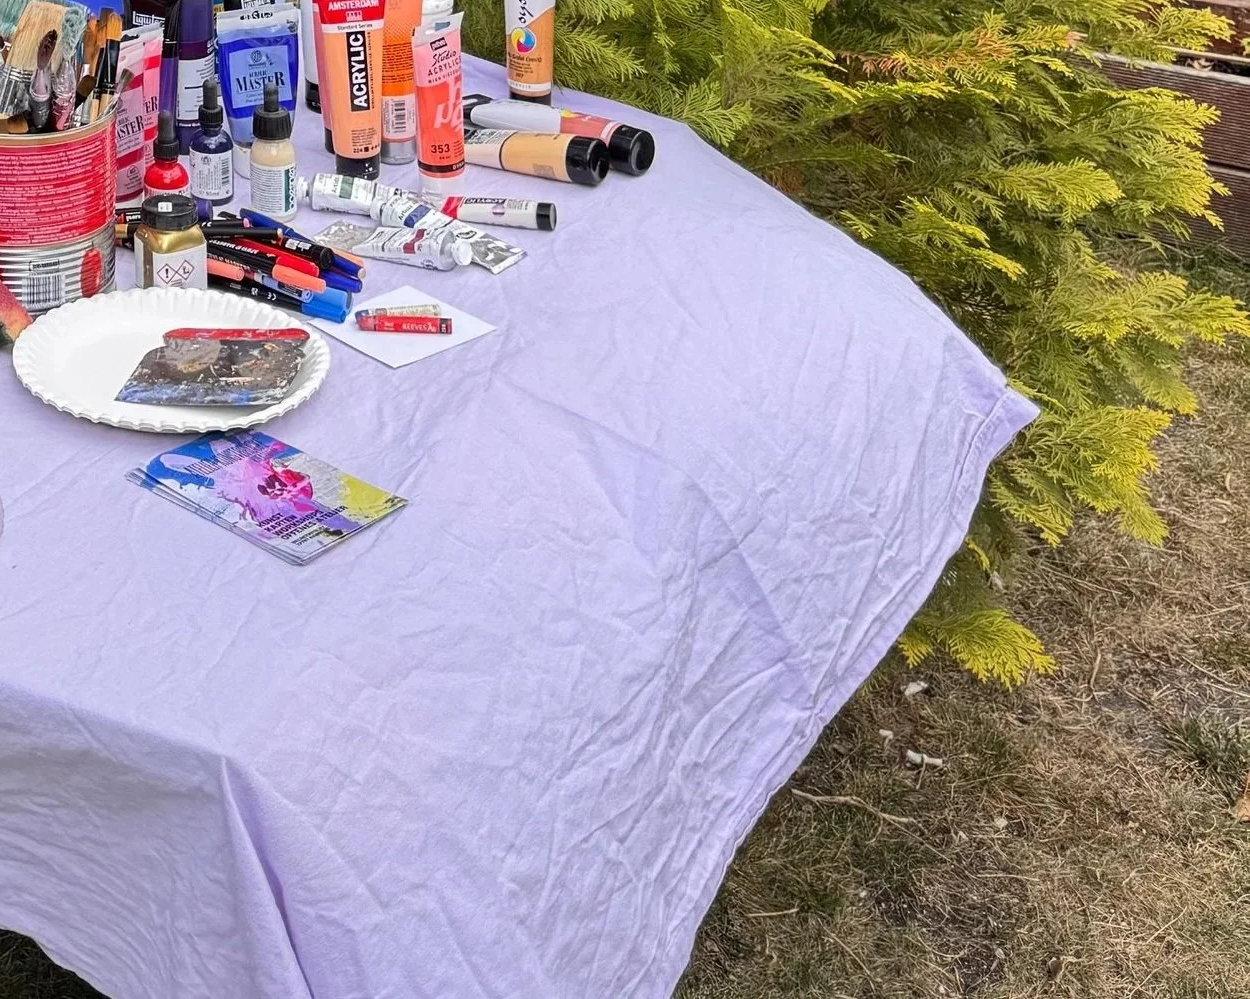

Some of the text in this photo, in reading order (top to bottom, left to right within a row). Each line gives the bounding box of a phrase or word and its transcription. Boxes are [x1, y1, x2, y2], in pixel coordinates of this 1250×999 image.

[432, 50, 457, 67] Studio
[349, 32, 368, 107] ACRYLIC
[236, 71, 285, 92] MASTER
[430, 143, 450, 154] 353
[256, 512, 284, 528] KUNST
[264, 514, 297, 532] KARTEN
[272, 509, 324, 536] WORKSHOPS
[281, 520, 317, 540] OFFENES
[315, 505, 348, 523] ATELIER
